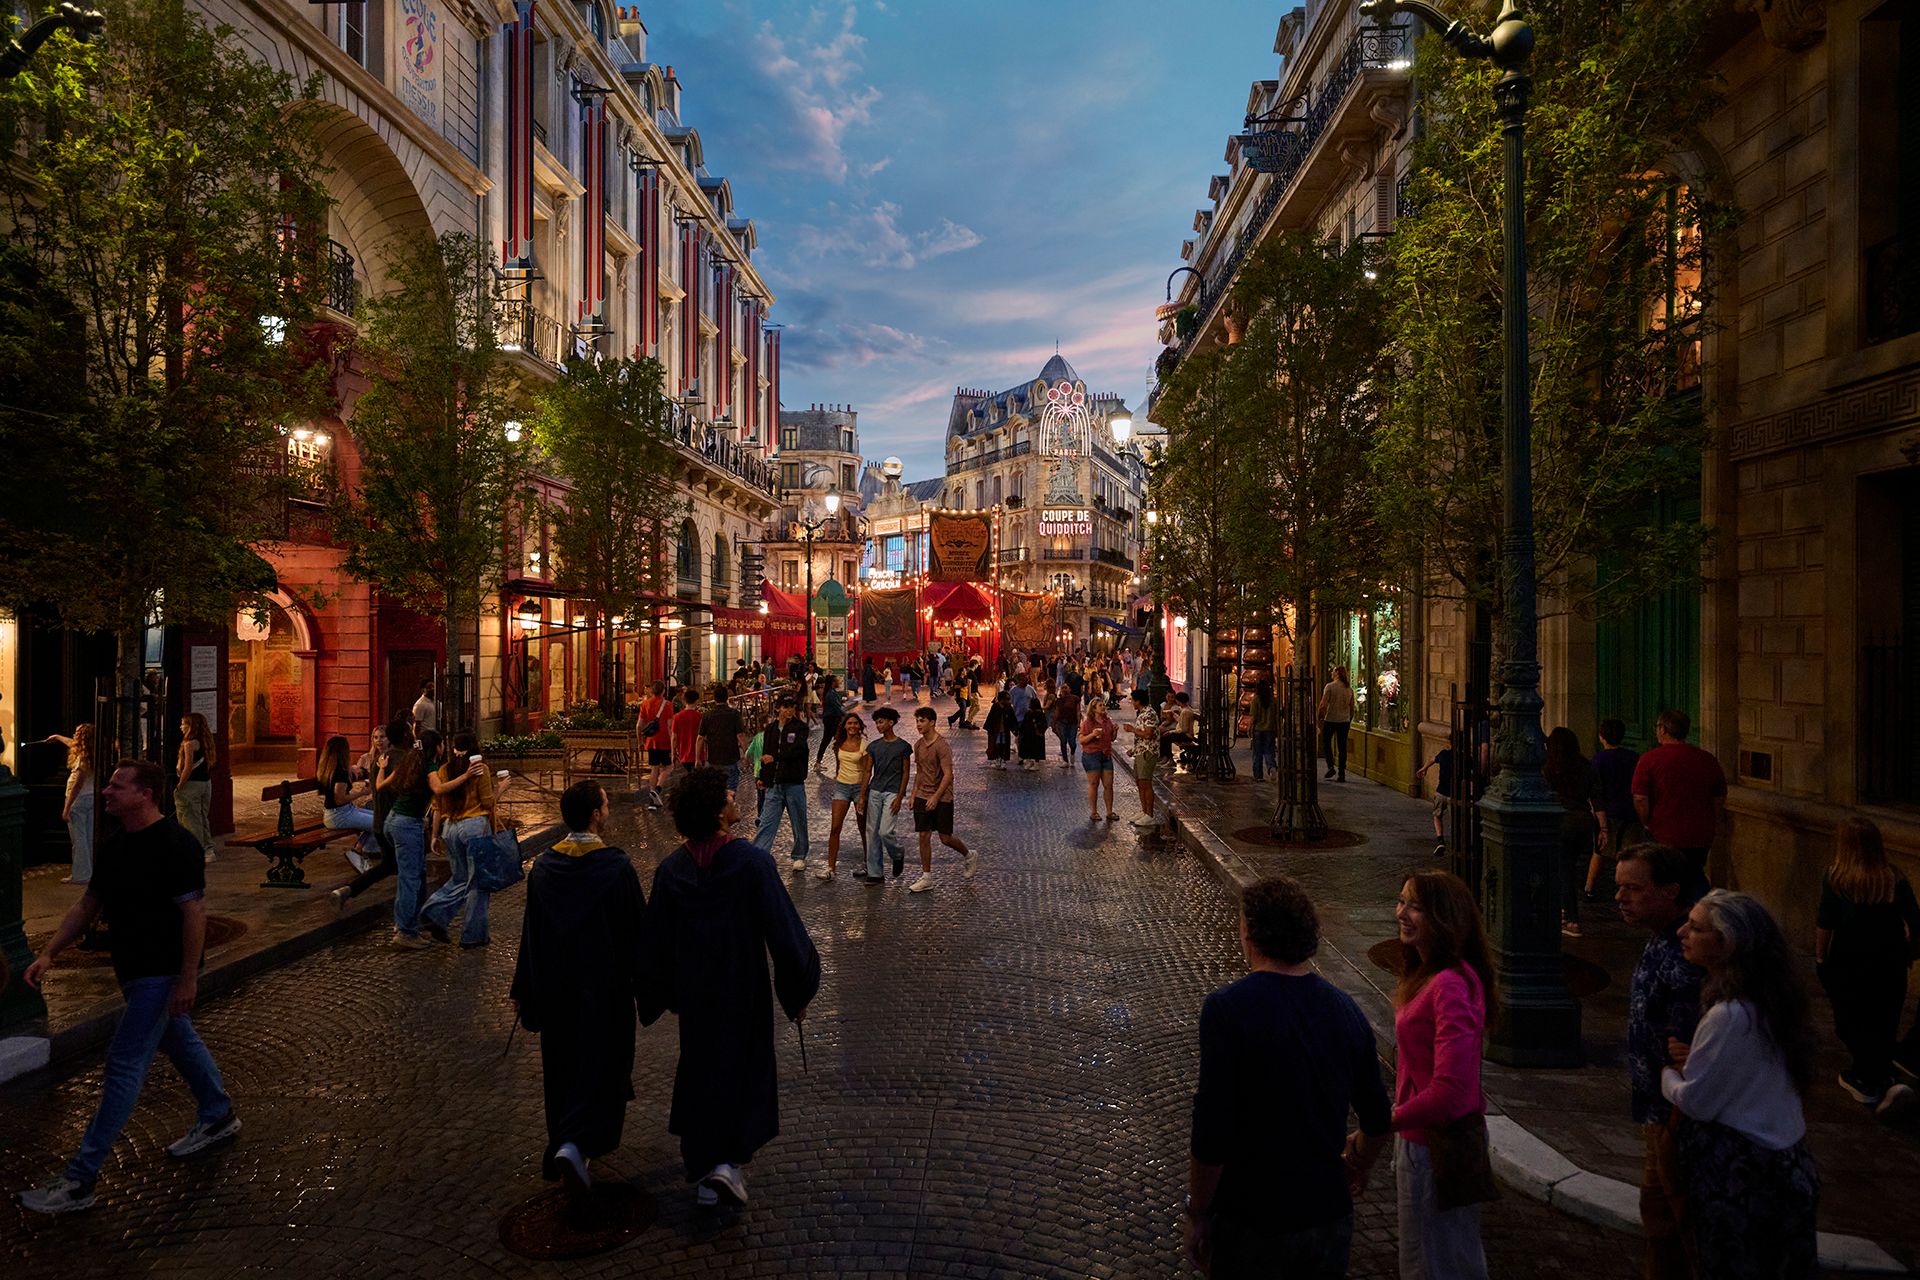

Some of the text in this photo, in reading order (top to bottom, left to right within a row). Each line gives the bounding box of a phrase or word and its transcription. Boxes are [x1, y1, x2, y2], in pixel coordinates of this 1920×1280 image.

[1042, 510, 1089, 522] COUPE DE
[1039, 522, 1092, 535] QUIDDITCH
